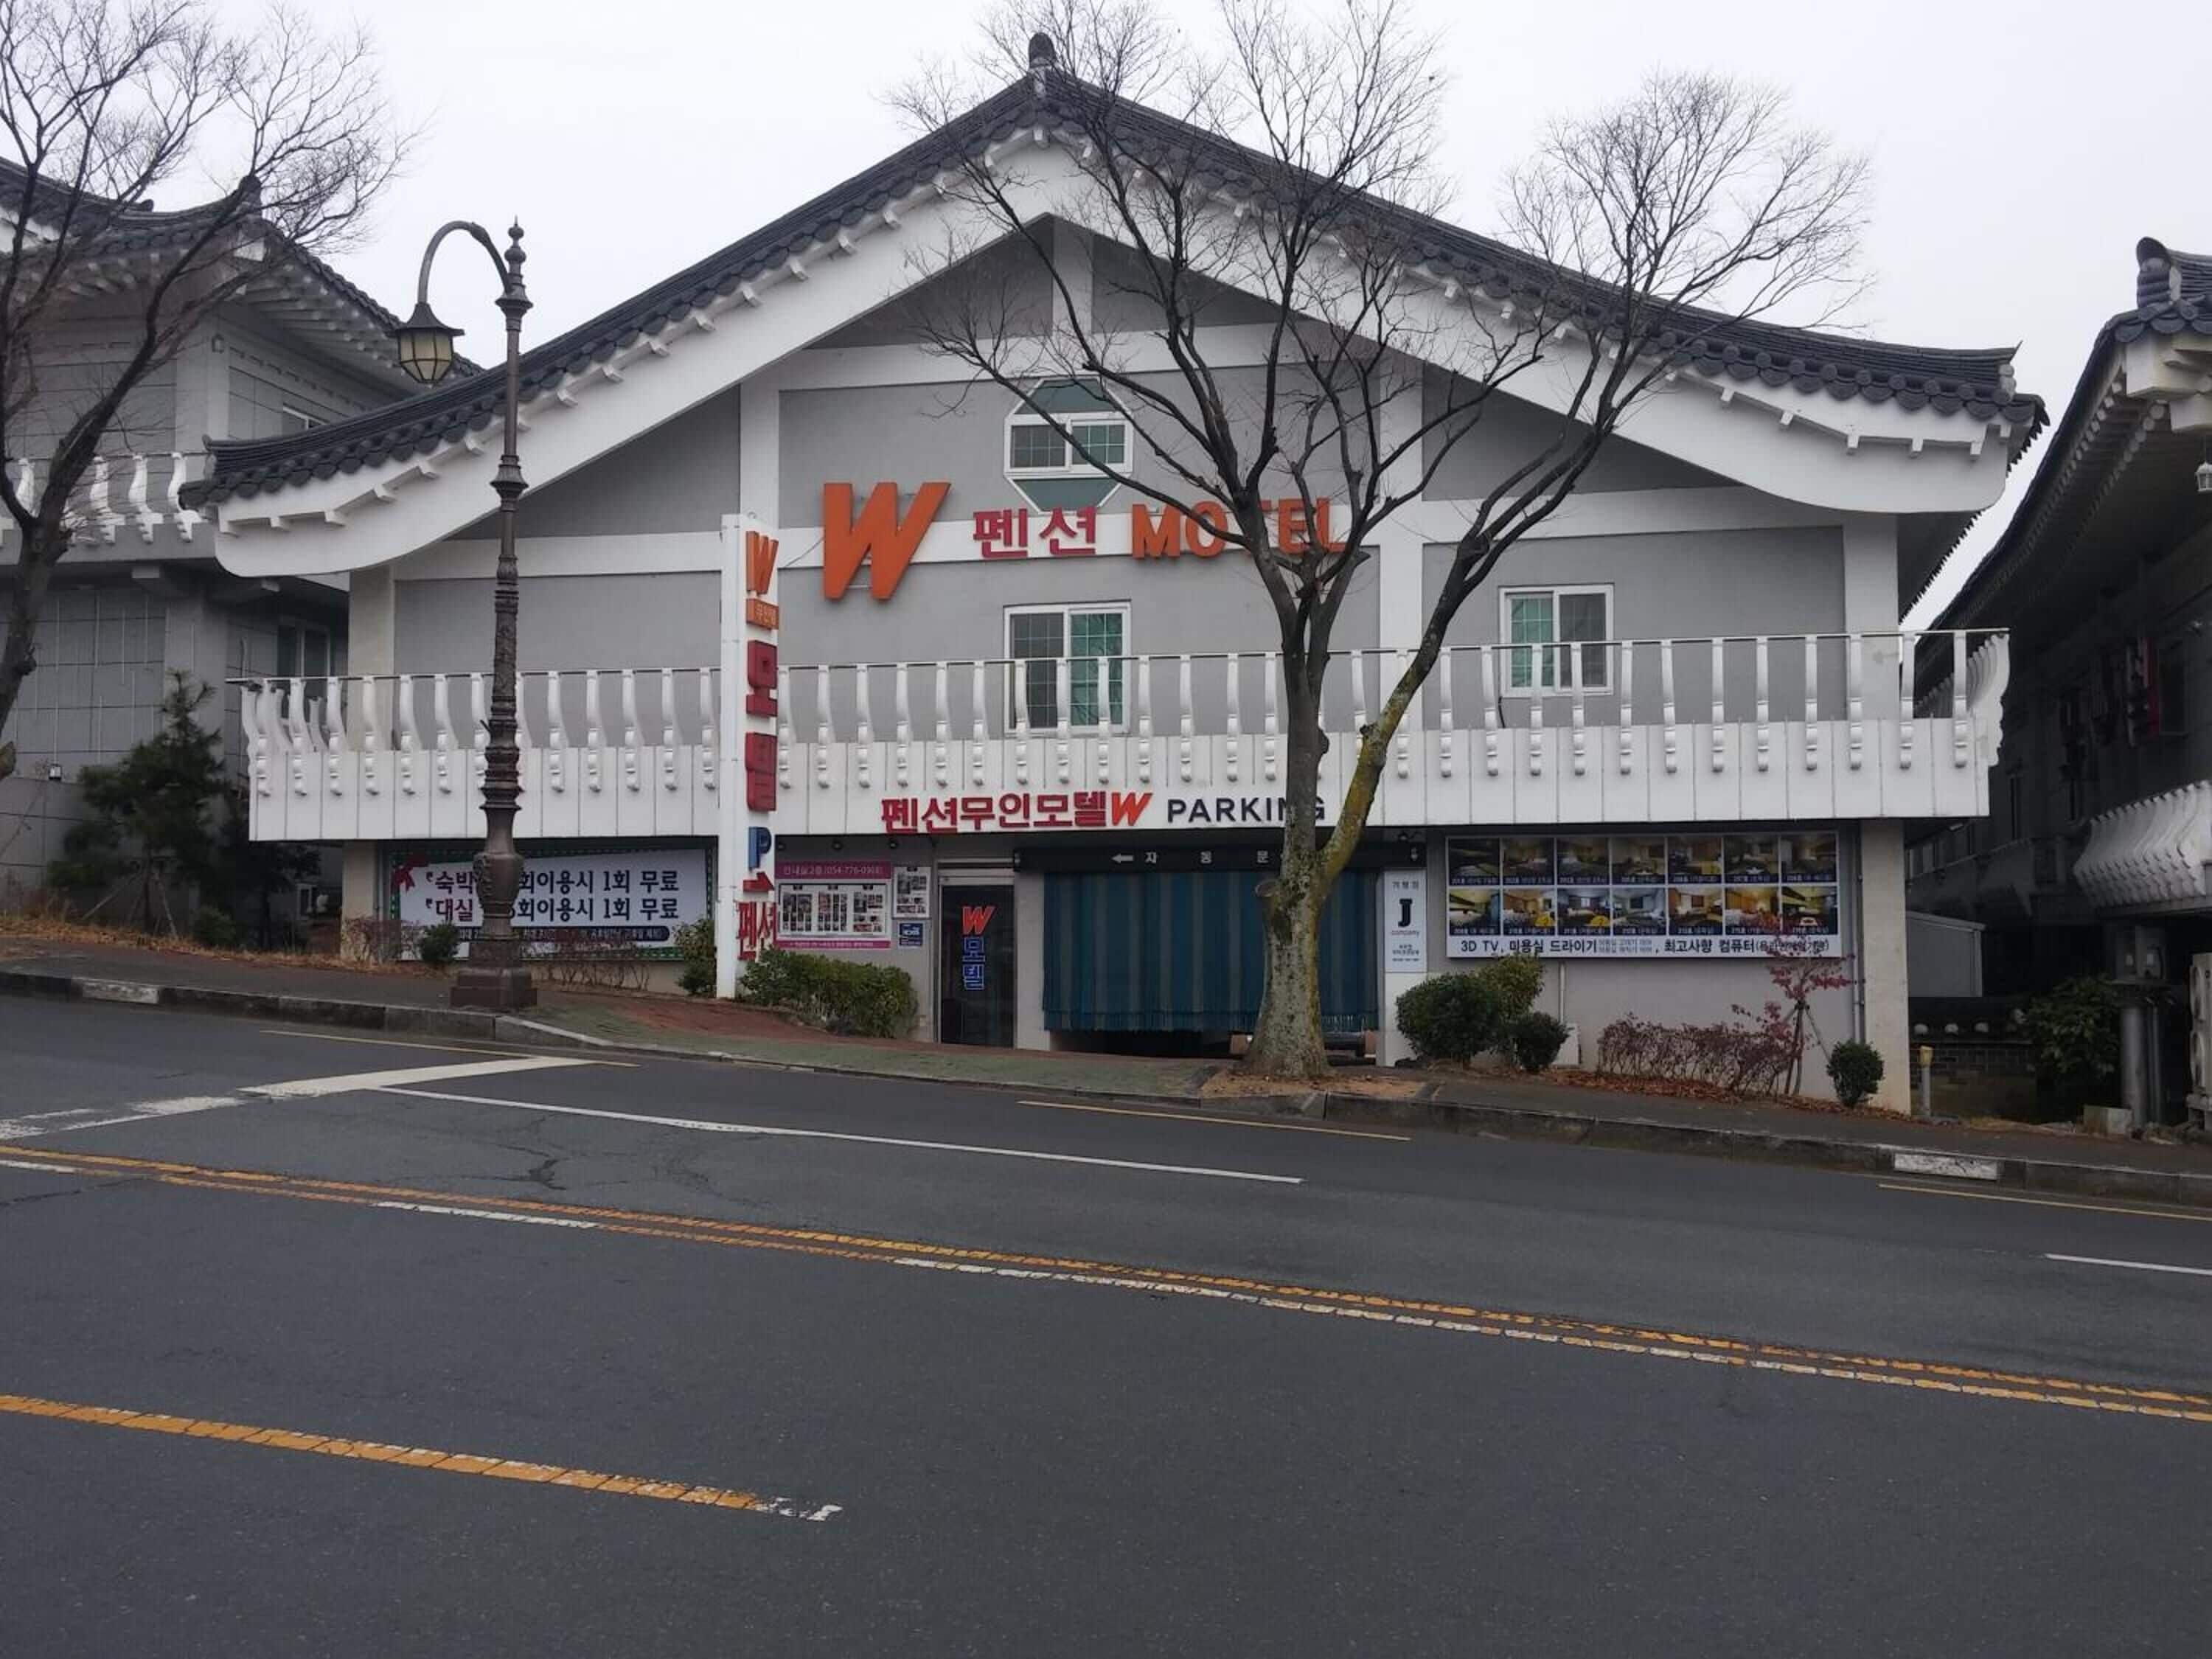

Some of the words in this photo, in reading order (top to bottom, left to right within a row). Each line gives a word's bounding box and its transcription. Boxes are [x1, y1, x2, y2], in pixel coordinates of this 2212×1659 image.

[822, 483, 950, 601] W
[975, 508, 1096, 558] 펜션
[748, 532, 779, 596] W
[748, 827, 772, 871] P
[603, 870, 631, 893] 1회
[639, 871, 679, 894] 무료
[603, 898, 631, 921] 1회
[639, 898, 679, 921] 무료
[961, 905, 997, 936] W
[1398, 898, 1413, 928] J
[1461, 940, 1477, 952] 3D
[1509, 939, 1545, 953] 미용실
[1549, 939, 1597, 953] 드라이기
[961, 936, 986, 990] 모텔
